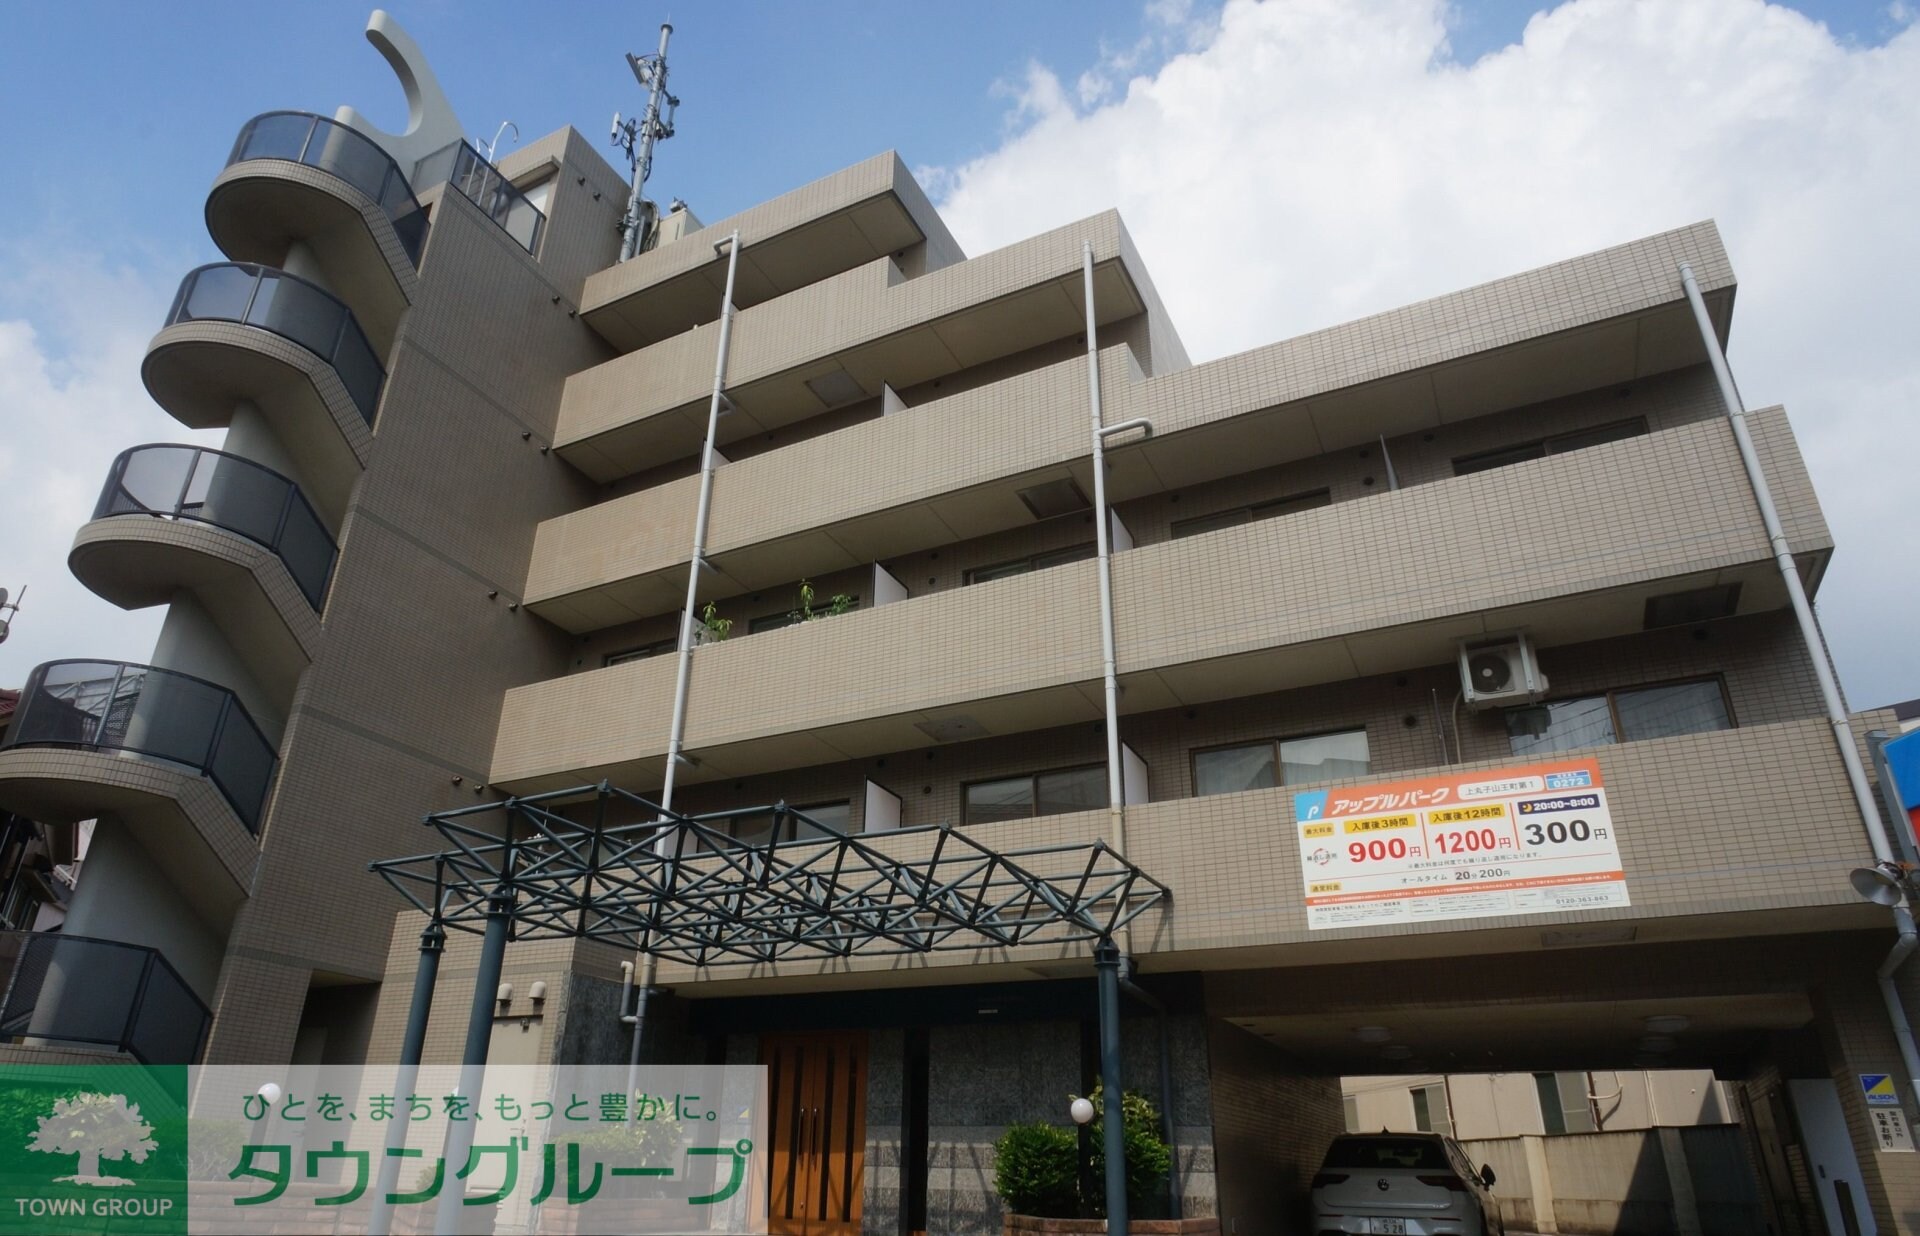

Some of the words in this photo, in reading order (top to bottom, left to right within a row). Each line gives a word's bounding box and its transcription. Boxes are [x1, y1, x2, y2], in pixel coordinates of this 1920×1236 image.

[1553, 777, 1585, 788] 0272
[1331, 787, 1450, 815] アップルパーク
[1352, 817, 1409, 832] 入庫後3時間
[1433, 807, 1501, 823] 入庫後12時間
[1434, 828, 1511, 854] 1200円
[1524, 819, 1608, 846] 300円
[1348, 837, 1422, 863] 900円
[1401, 873, 1448, 884] オールタイム
